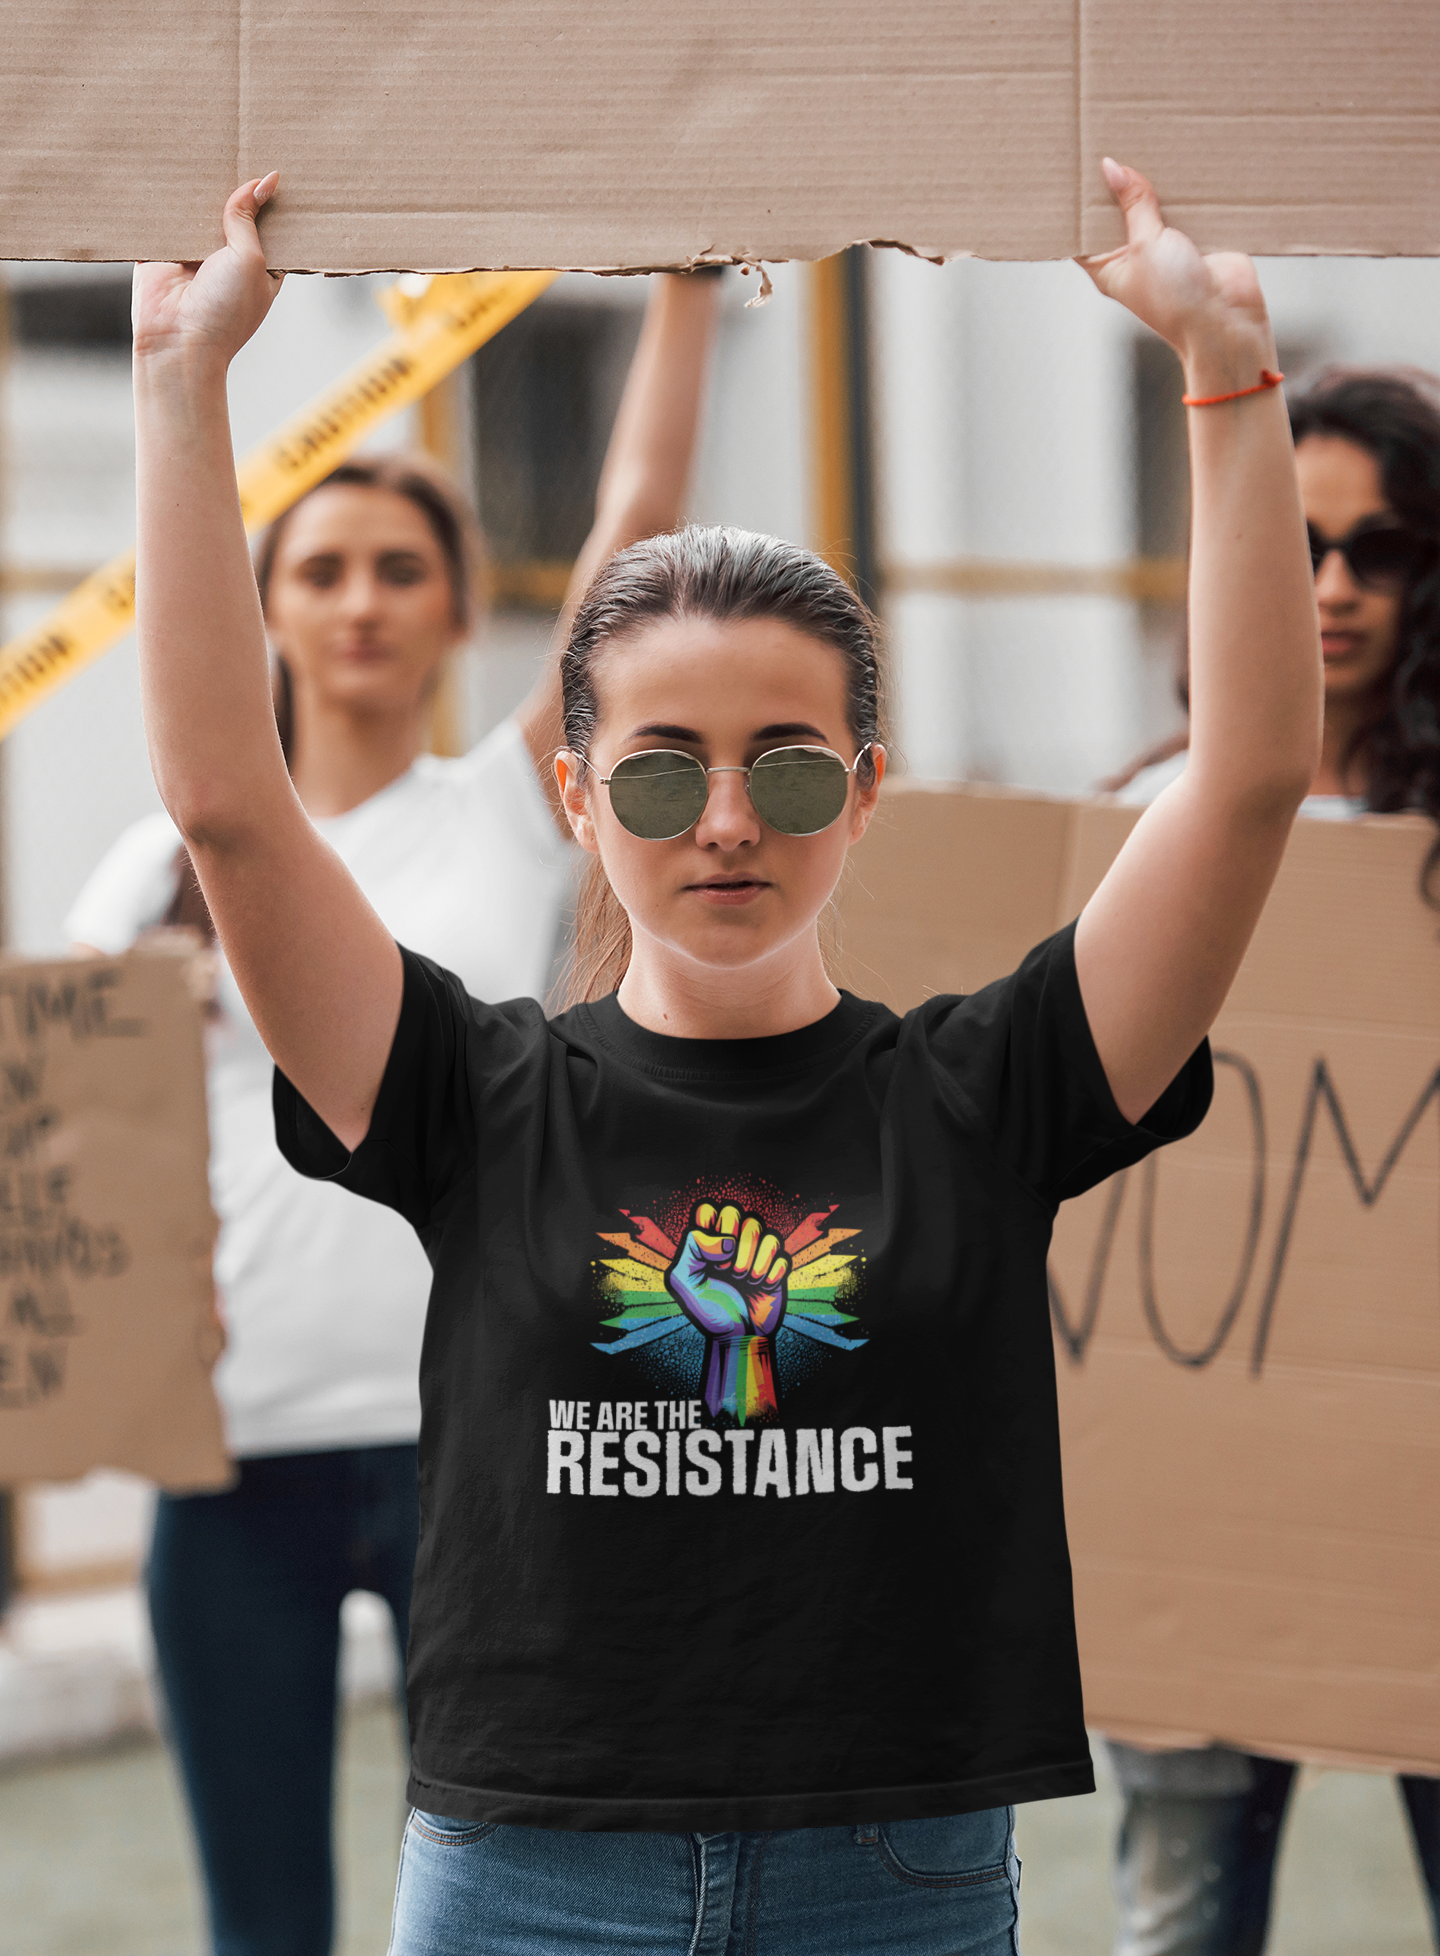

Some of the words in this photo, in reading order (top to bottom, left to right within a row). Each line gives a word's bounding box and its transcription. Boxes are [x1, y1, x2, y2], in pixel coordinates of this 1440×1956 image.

[549, 1399, 590, 1431] WE
[597, 1400, 648, 1430] ARE
[654, 1400, 702, 1430] THE
[546, 1426, 914, 1499] RESISTANCE
